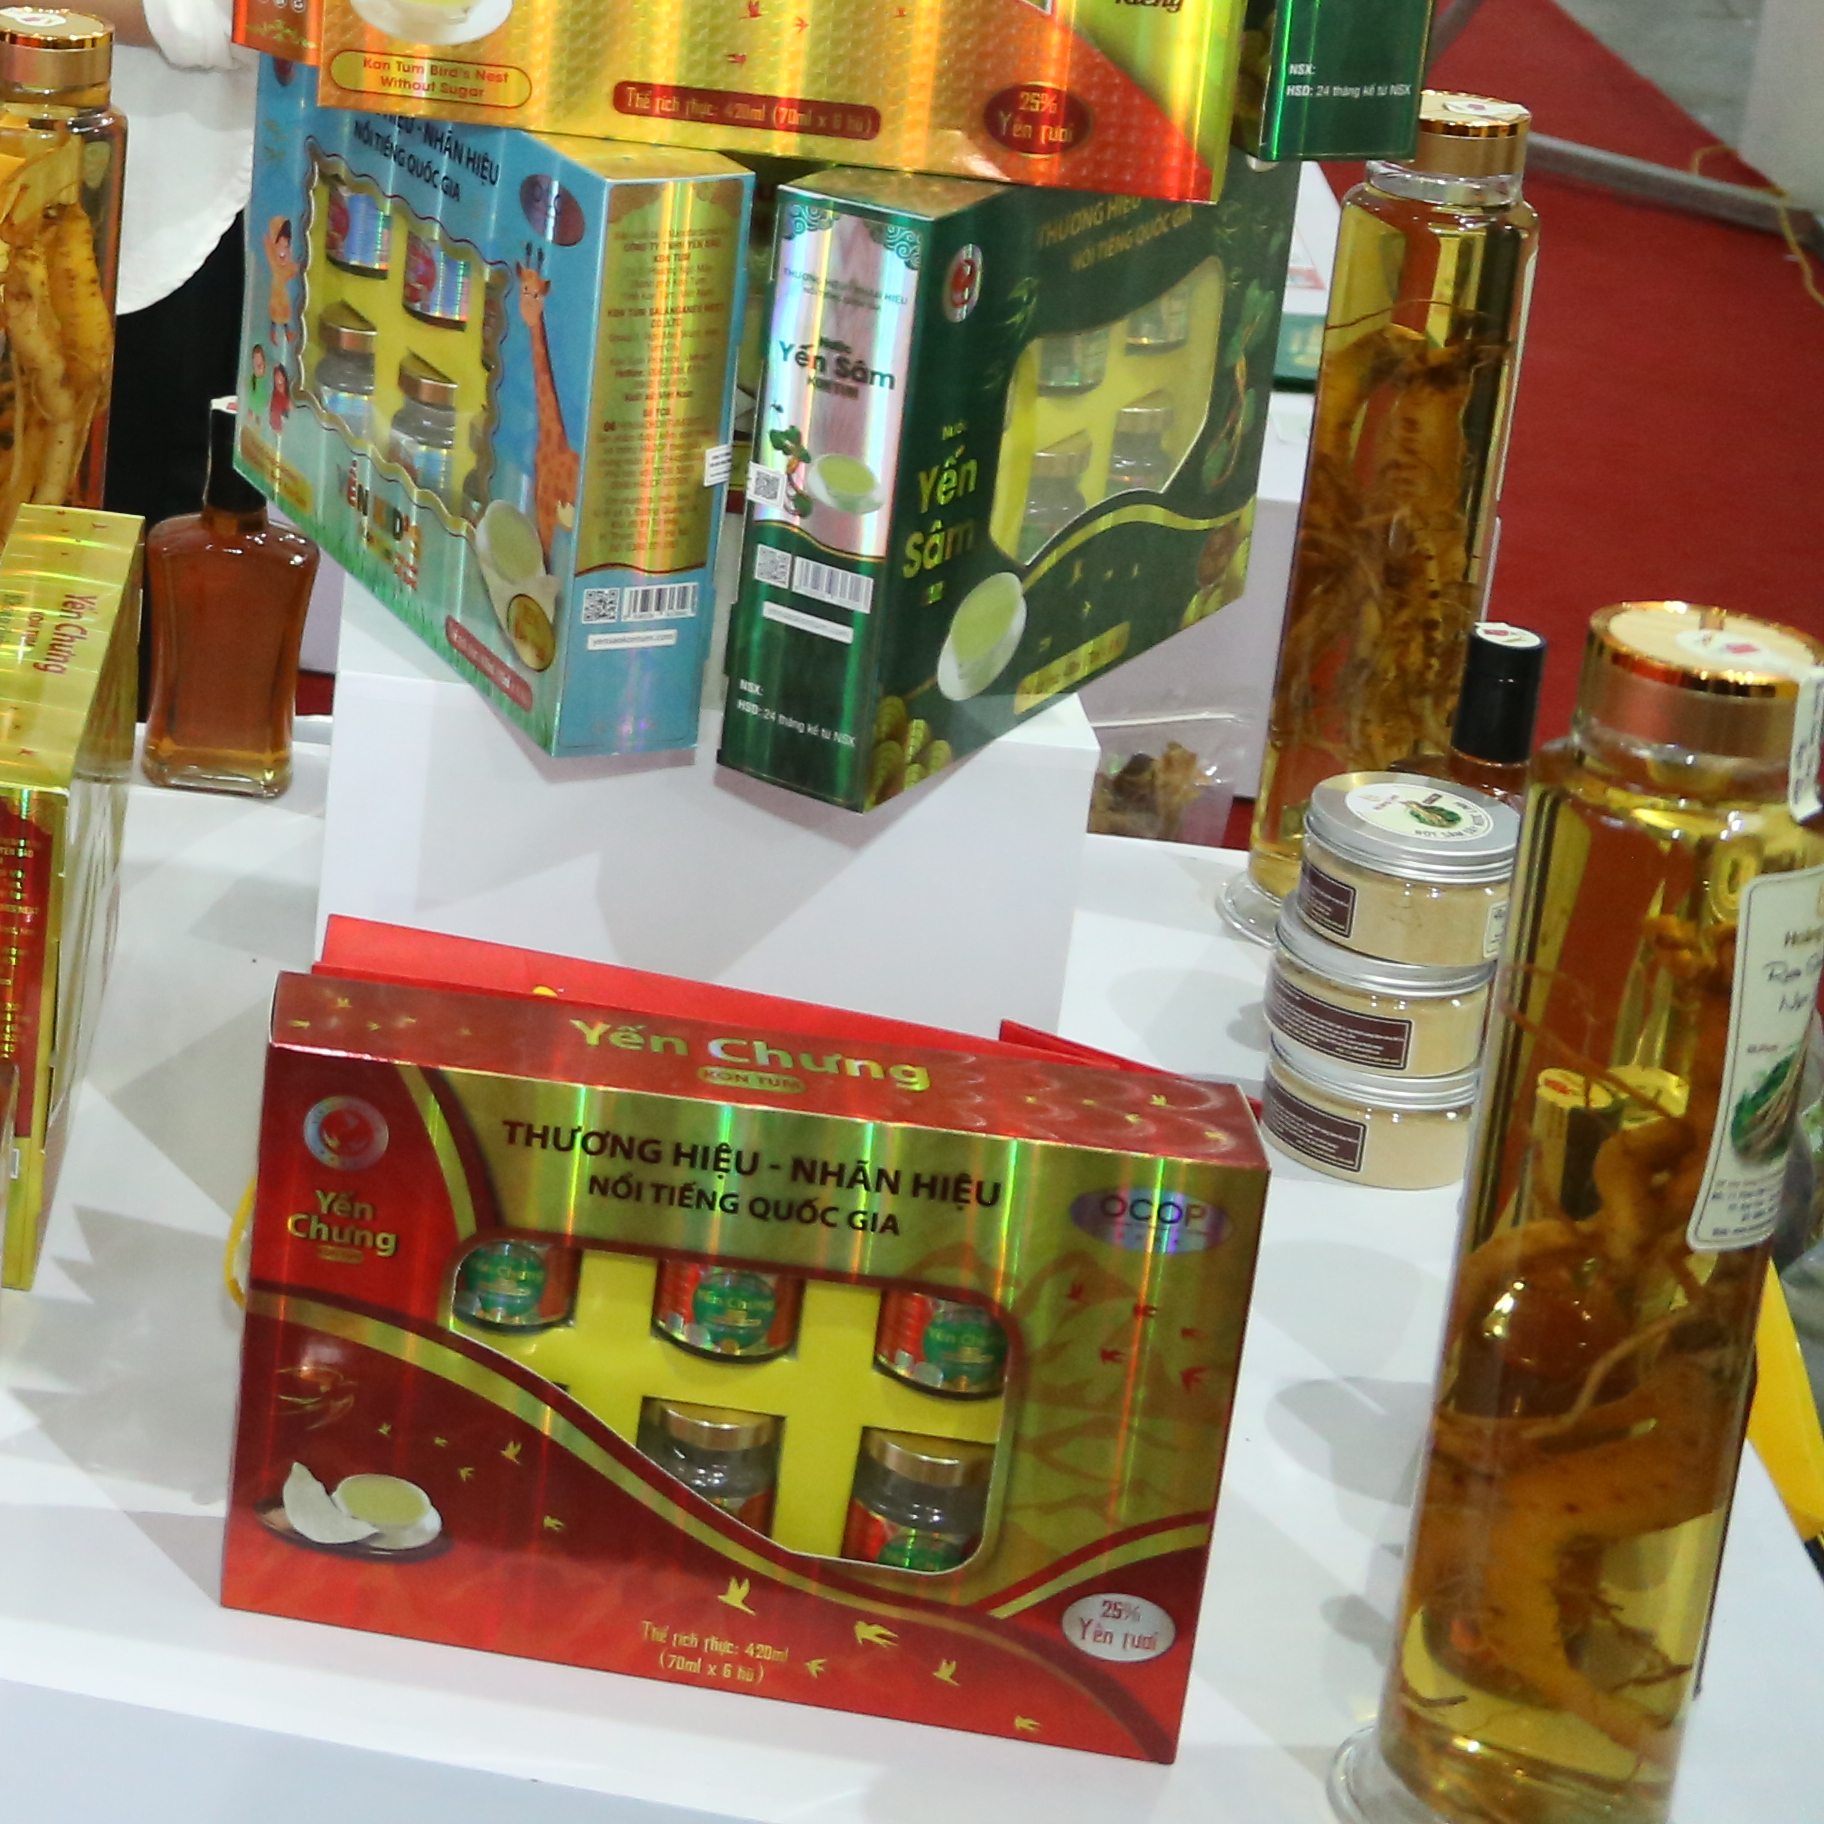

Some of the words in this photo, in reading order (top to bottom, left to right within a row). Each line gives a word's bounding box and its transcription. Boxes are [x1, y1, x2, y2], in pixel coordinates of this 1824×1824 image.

[380, 76, 436, 93] Without
[440, 83, 484, 99] Sugar
[423, 122, 464, 165] NHÃN
[466, 147, 500, 186] HIỆU
[779, 340, 826, 372] Yến
[834, 356, 896, 390] Sâm
[918, 444, 978, 514] Yến
[903, 519, 975, 579] Sâm
[59, 594, 98, 619] Yến
[32, 622, 88, 674] Chưng
[571, 1018, 689, 1057] Yến
[707, 1038, 932, 1093] Chưng
[503, 1118, 663, 1165] THƯƠNG
[673, 1142, 760, 1179] HIỆU
[792, 1159, 901, 1196] NHÃN
[912, 1172, 1002, 1213] HIỆU
[315, 1189, 375, 1221] Yến
[588, 1164, 643, 1203] NỔI
[652, 1177, 740, 1215] TIẾNG
[749, 1194, 840, 1230] QUỐC
[848, 1208, 902, 1237] GIA
[1099, 1193, 1209, 1228] OCOP
[287, 1213, 397, 1257] Chưng
[1101, 1600, 1143, 1623] 25%
[659, 1650, 702, 1674] (70ml
[707, 1664, 717, 1676] x
[723, 1663, 732, 1678] 6
[745, 1642, 789, 1664] 420ml
